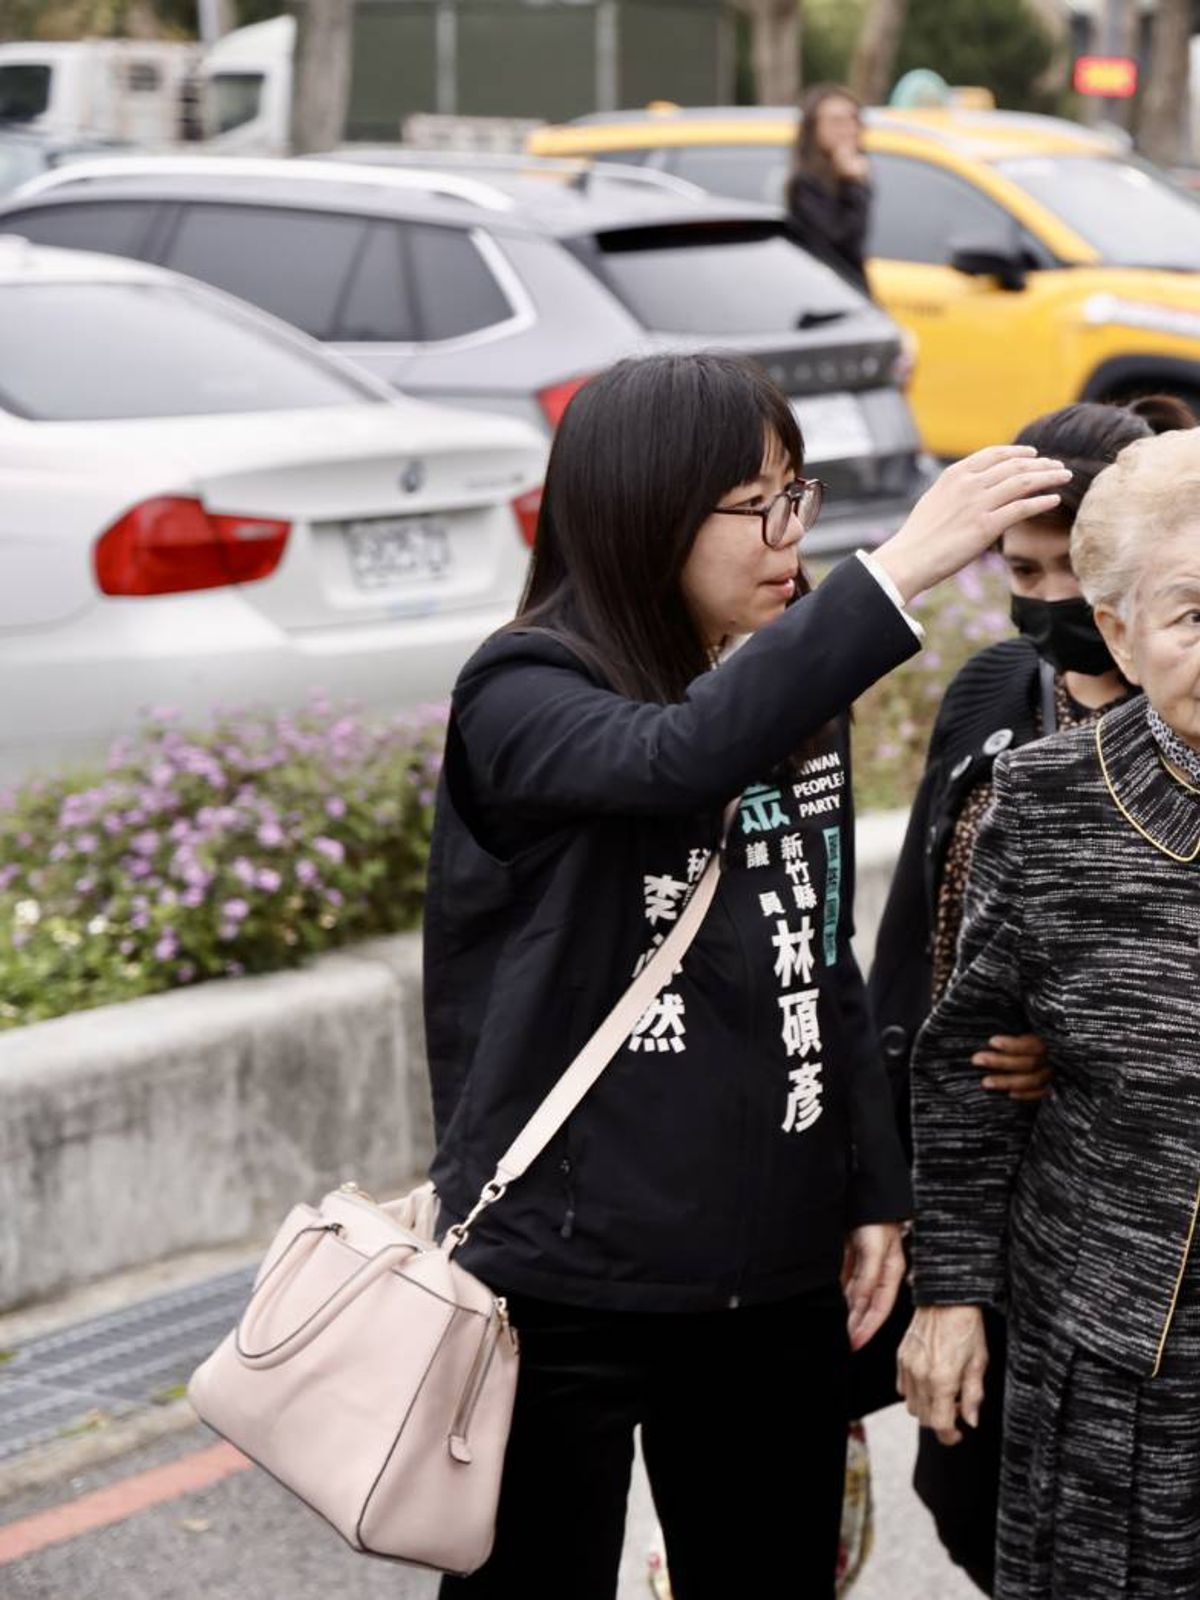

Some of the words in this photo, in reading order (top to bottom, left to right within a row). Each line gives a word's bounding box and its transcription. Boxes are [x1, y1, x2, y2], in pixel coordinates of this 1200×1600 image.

[801, 752, 841, 776] IWAN
[799, 794, 840, 818] PARTY
[746, 840, 786, 917] 議員
[780, 833, 817, 909] 新竹縣
[771, 915, 824, 1134] 林碩彥
